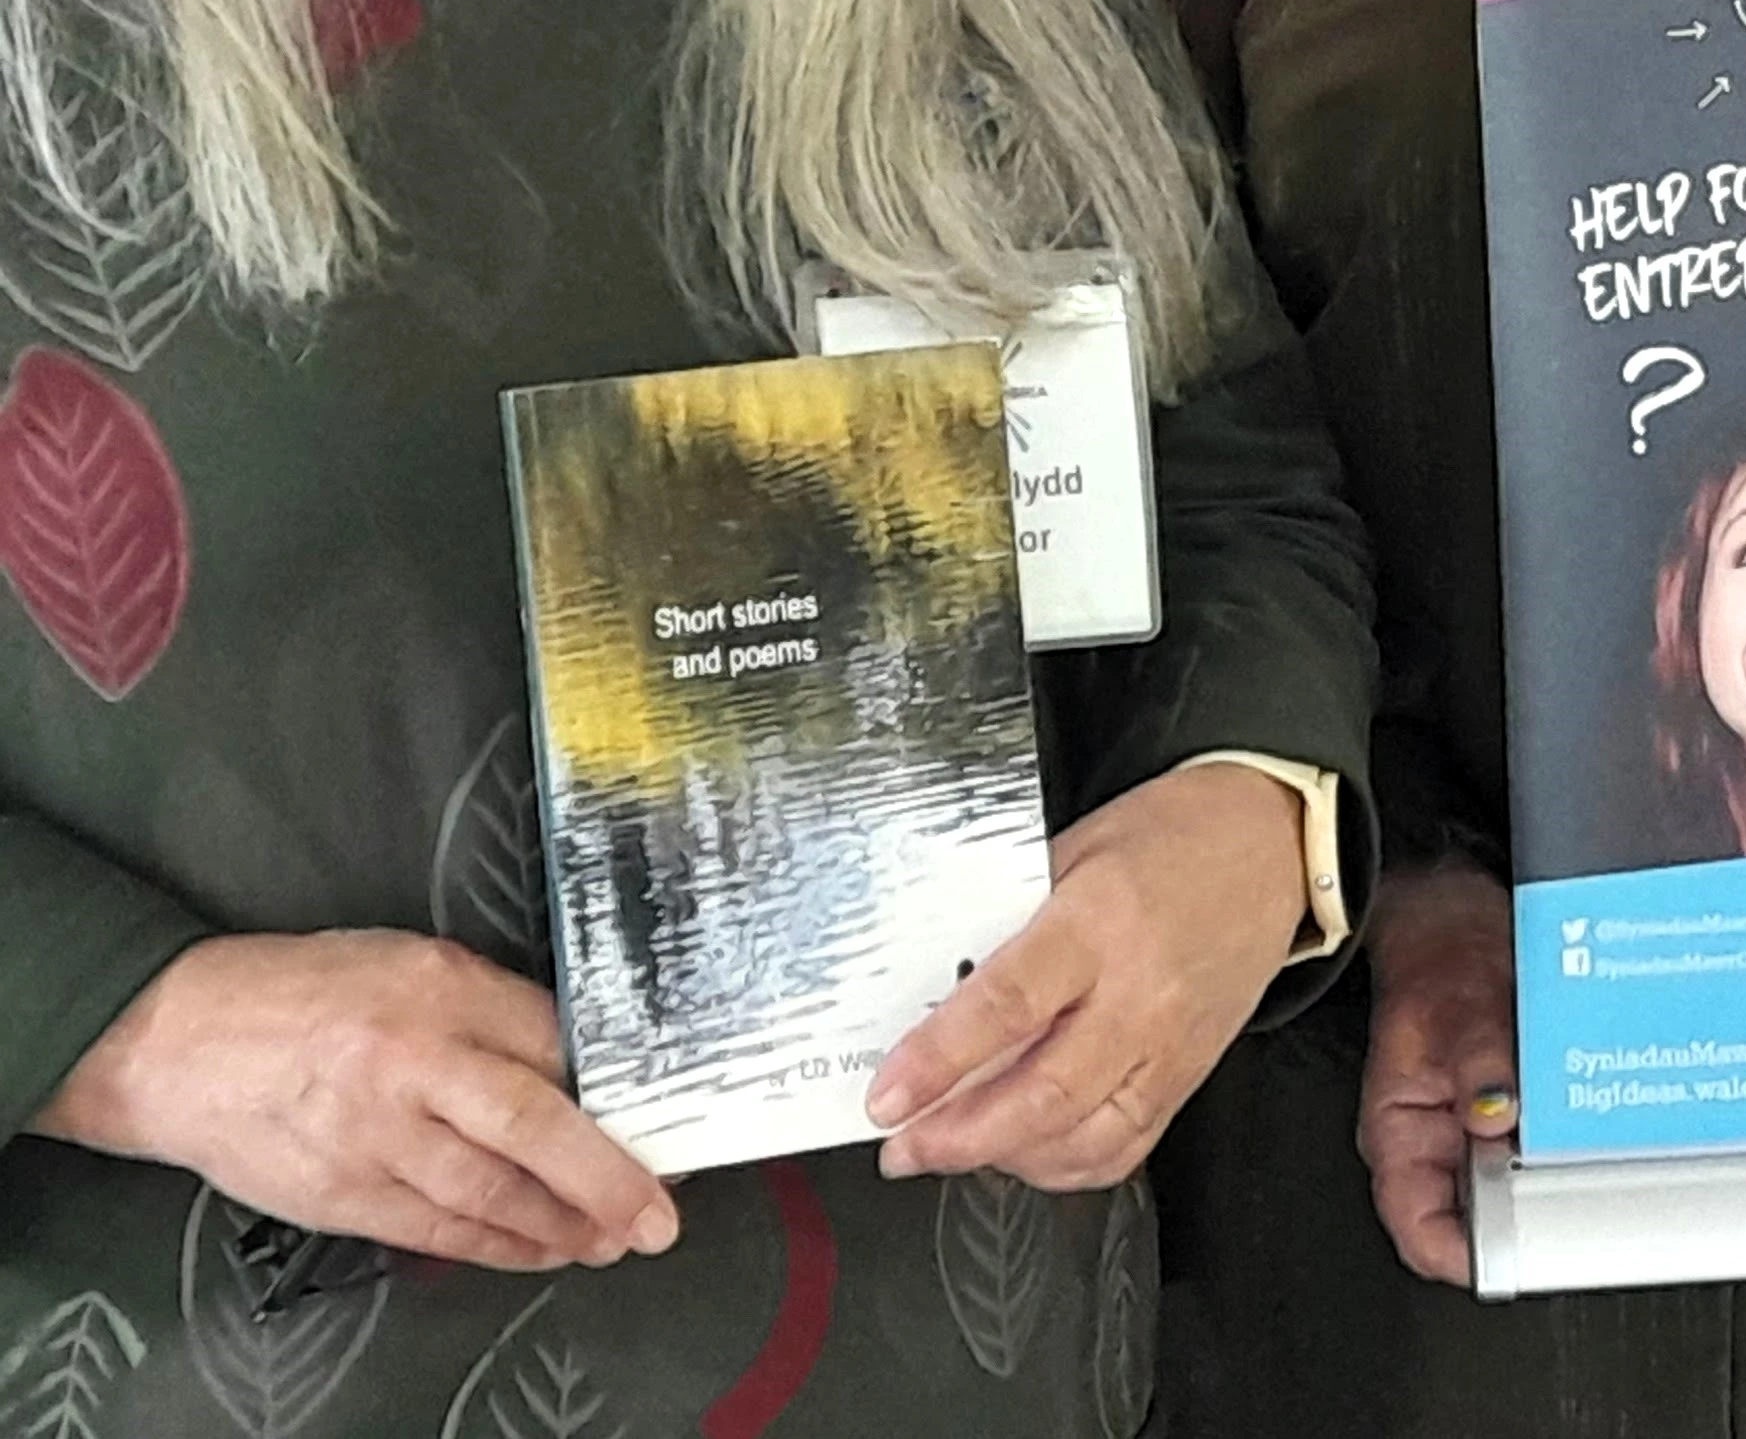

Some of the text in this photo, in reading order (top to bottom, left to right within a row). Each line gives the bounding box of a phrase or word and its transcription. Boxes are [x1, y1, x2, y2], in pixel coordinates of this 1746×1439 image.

[1570, 171, 1691, 252] HELP
[655, 591, 819, 639] Short stories
[673, 637, 820, 679] and poems
